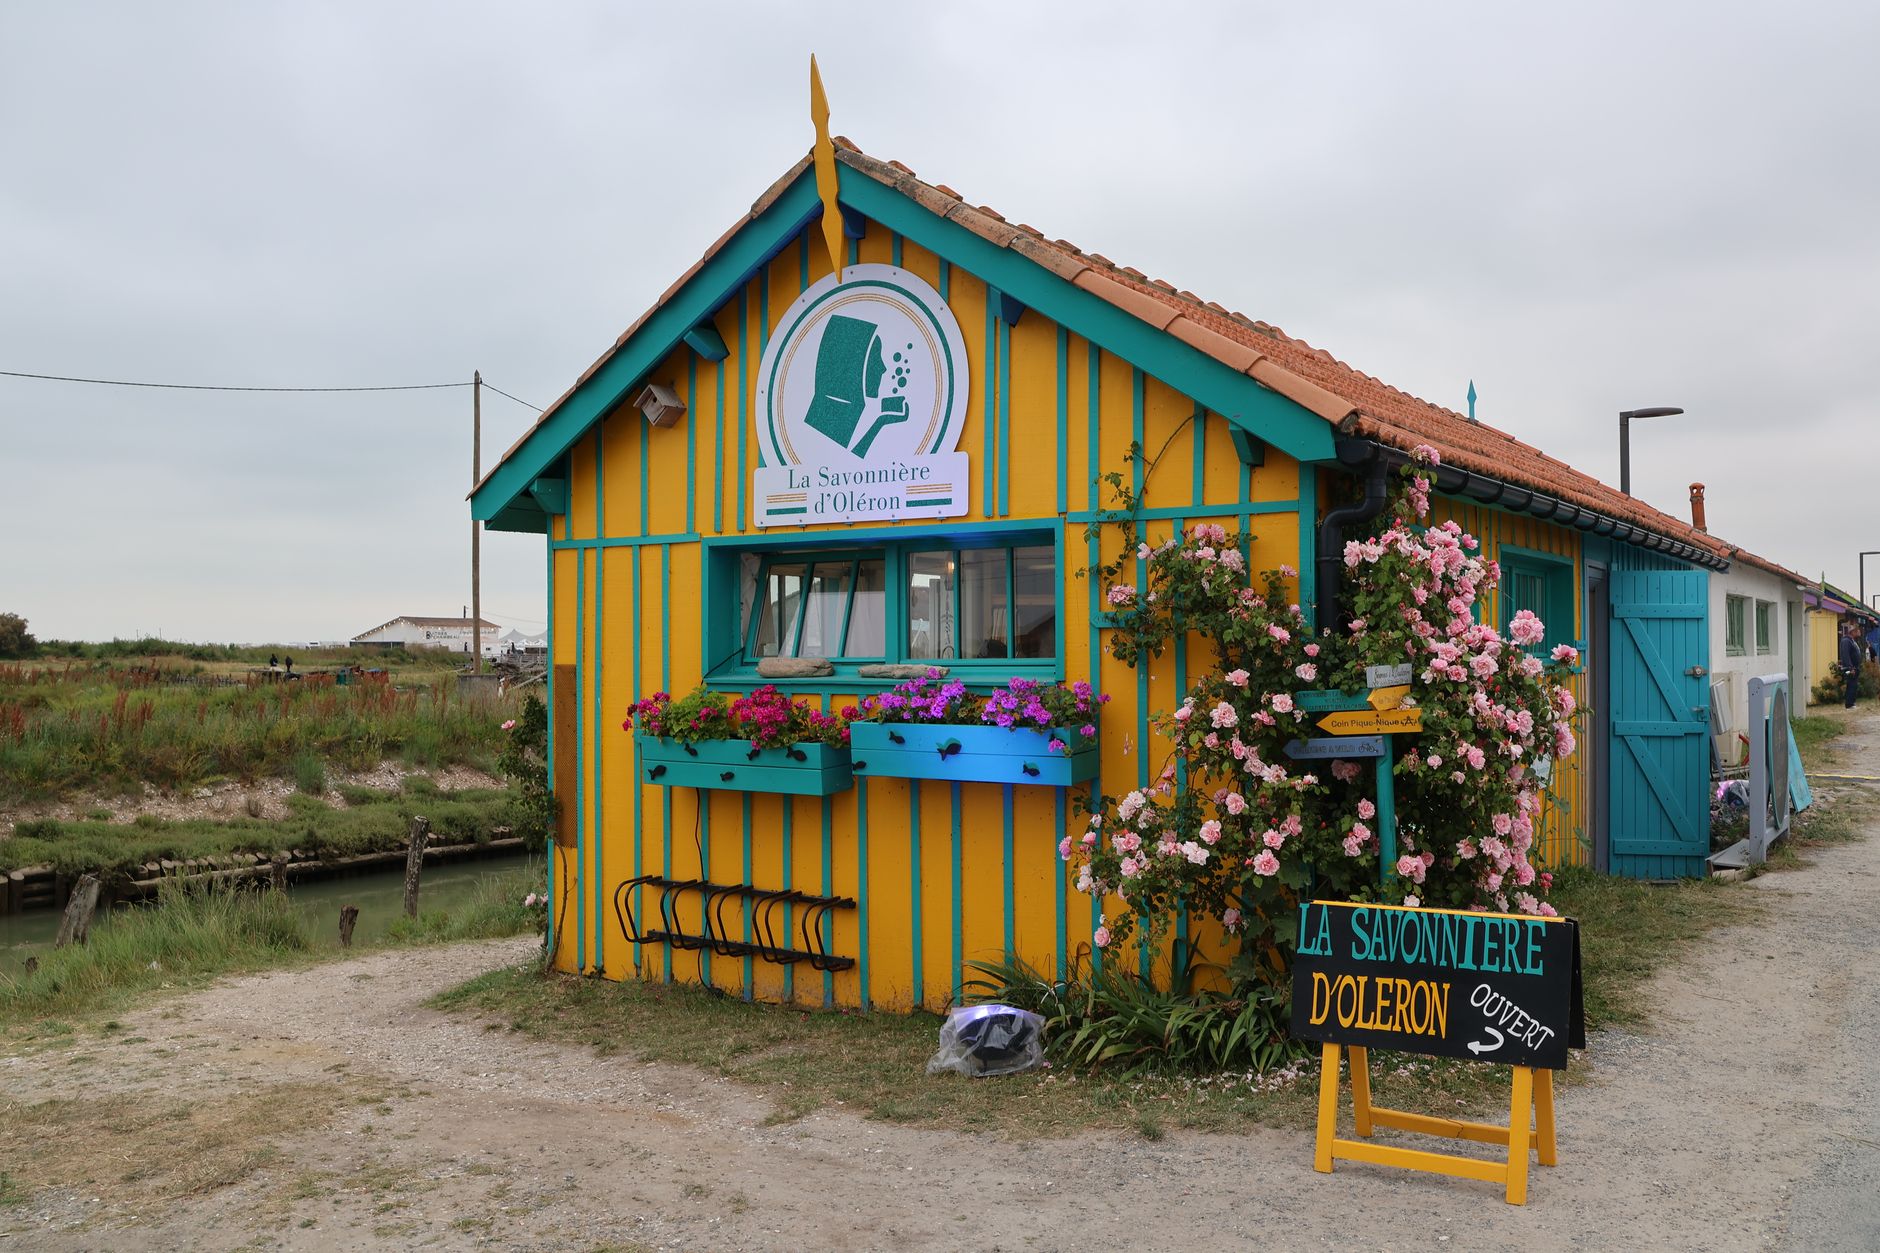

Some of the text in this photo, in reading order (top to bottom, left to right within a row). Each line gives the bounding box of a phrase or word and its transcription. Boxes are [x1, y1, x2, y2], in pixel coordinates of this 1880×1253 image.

[788, 461, 931, 489] La Savonnière
[1331, 718, 1400, 730] Coin Pique-Nique
[1297, 902, 1547, 976] LA SAVONNIERE
[1470, 983, 1555, 1050] OUVERT
